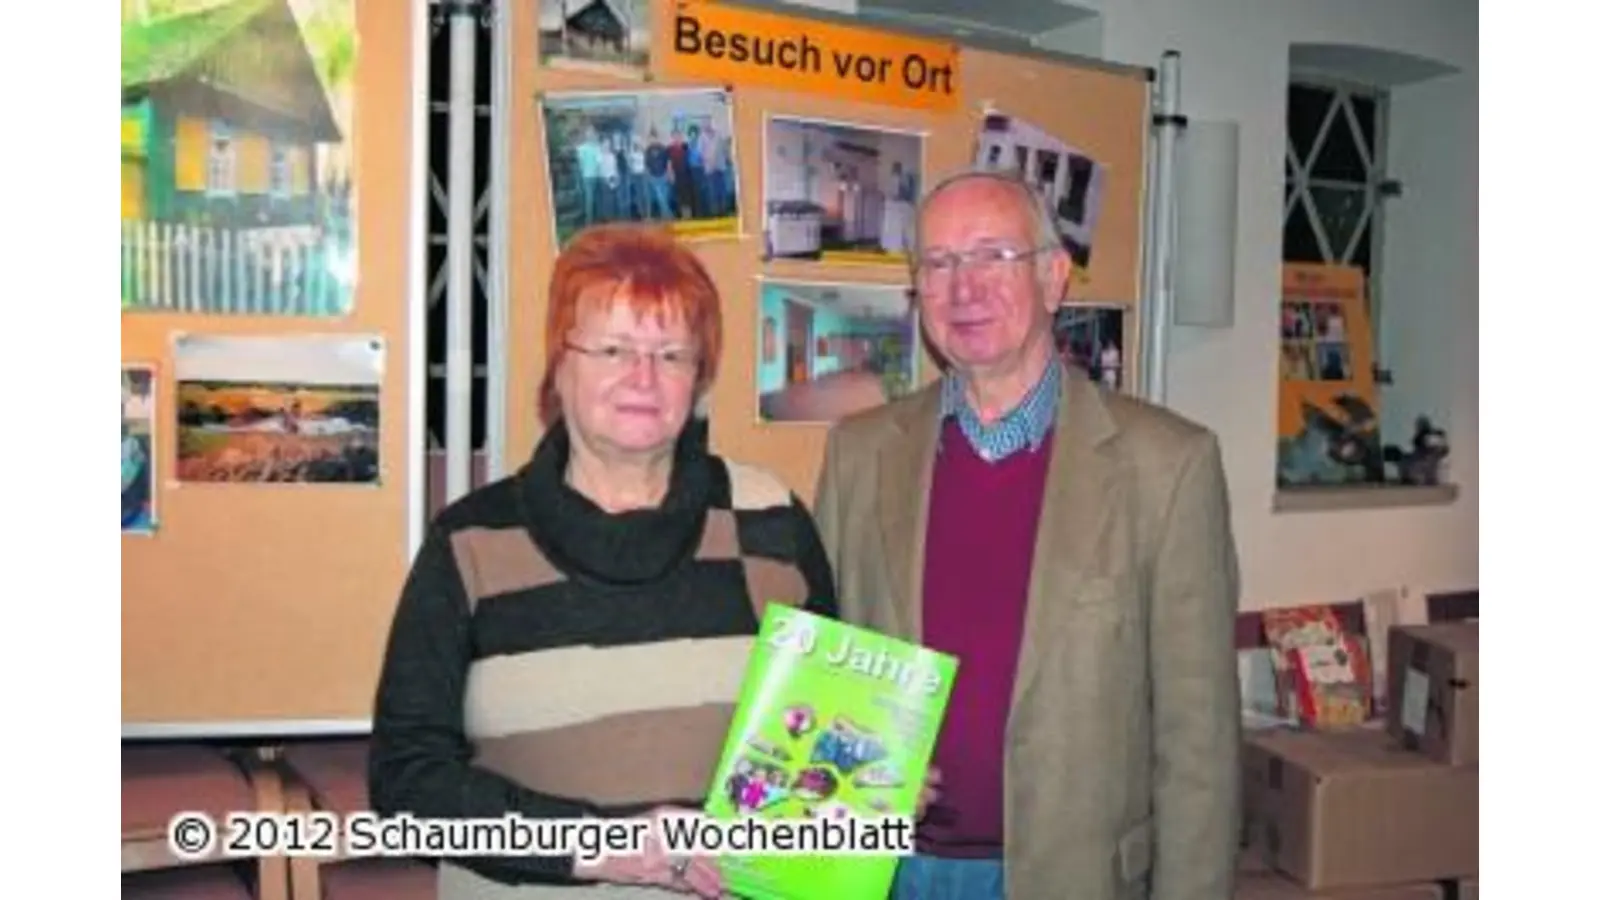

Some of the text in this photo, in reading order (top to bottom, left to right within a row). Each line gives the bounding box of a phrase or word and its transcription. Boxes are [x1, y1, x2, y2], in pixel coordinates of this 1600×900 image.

[673, 15, 953, 94] Besuch vor Ort
[769, 616, 942, 695] 20 Jahre
